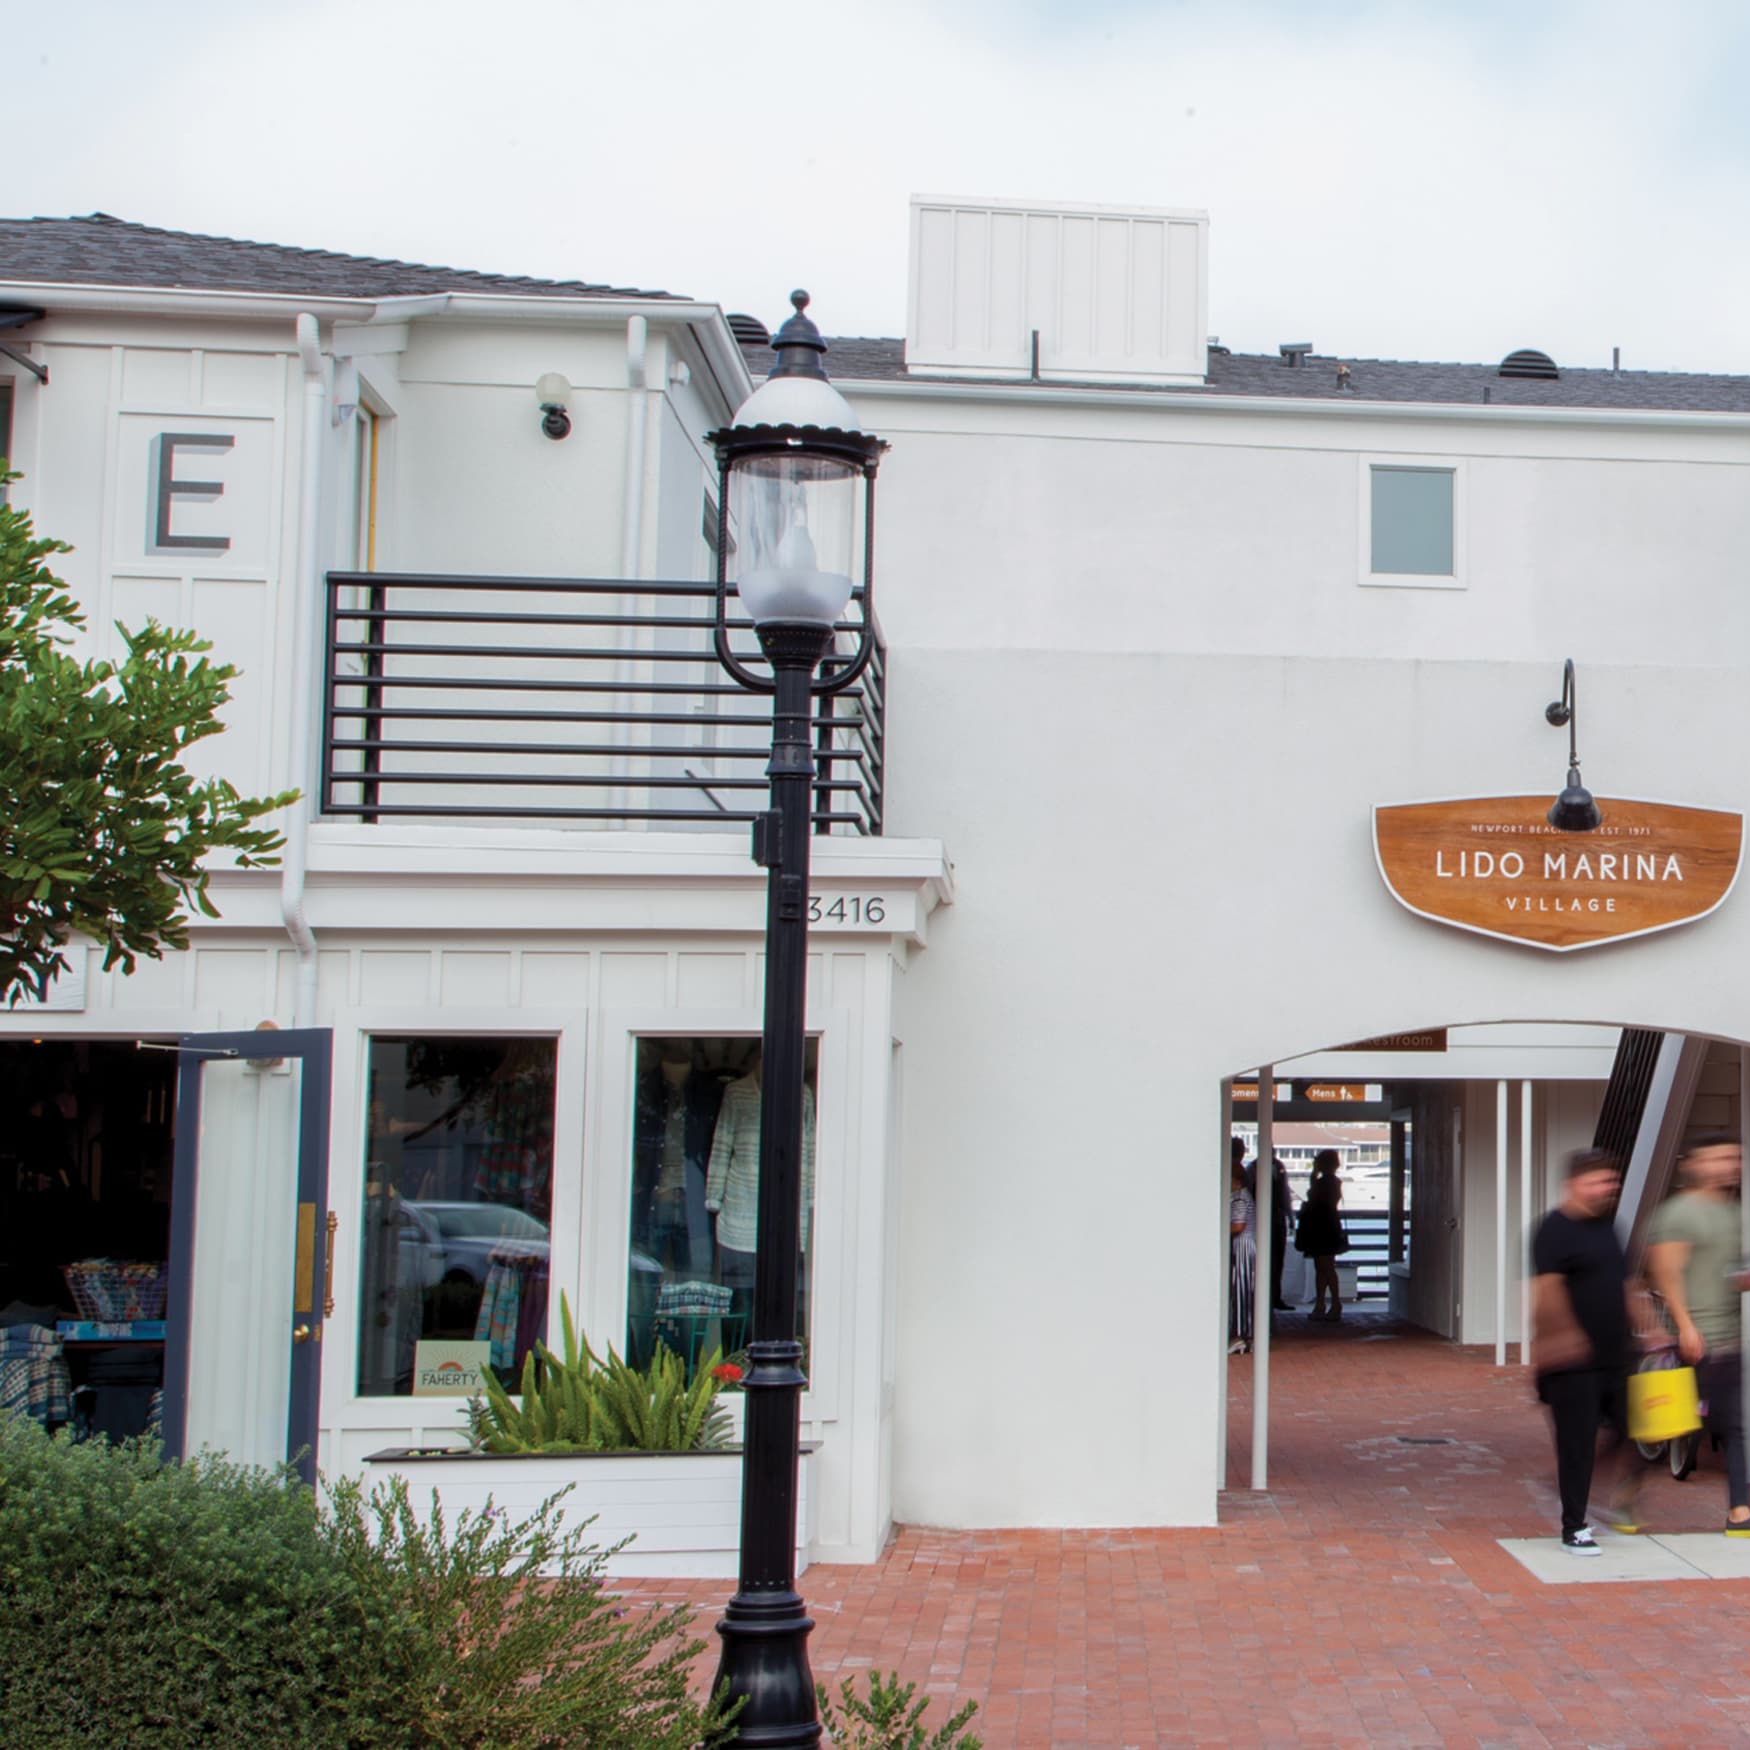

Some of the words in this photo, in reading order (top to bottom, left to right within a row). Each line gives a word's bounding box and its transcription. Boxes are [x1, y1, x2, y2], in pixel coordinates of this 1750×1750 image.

[153, 432, 235, 550] E
[1471, 825, 1523, 833] NEWPORT
[1529, 825, 1564, 834] BEAC
[1436, 851, 1524, 878] LIDO
[1543, 853, 1684, 880] MARINA
[807, 896, 885, 923] 3416
[1506, 897, 1616, 913] VILLAGE
[1232, 1089, 1259, 1098] omen
[1312, 1089, 1336, 1098] Mens
[422, 1373, 478, 1386] FAHERTY
